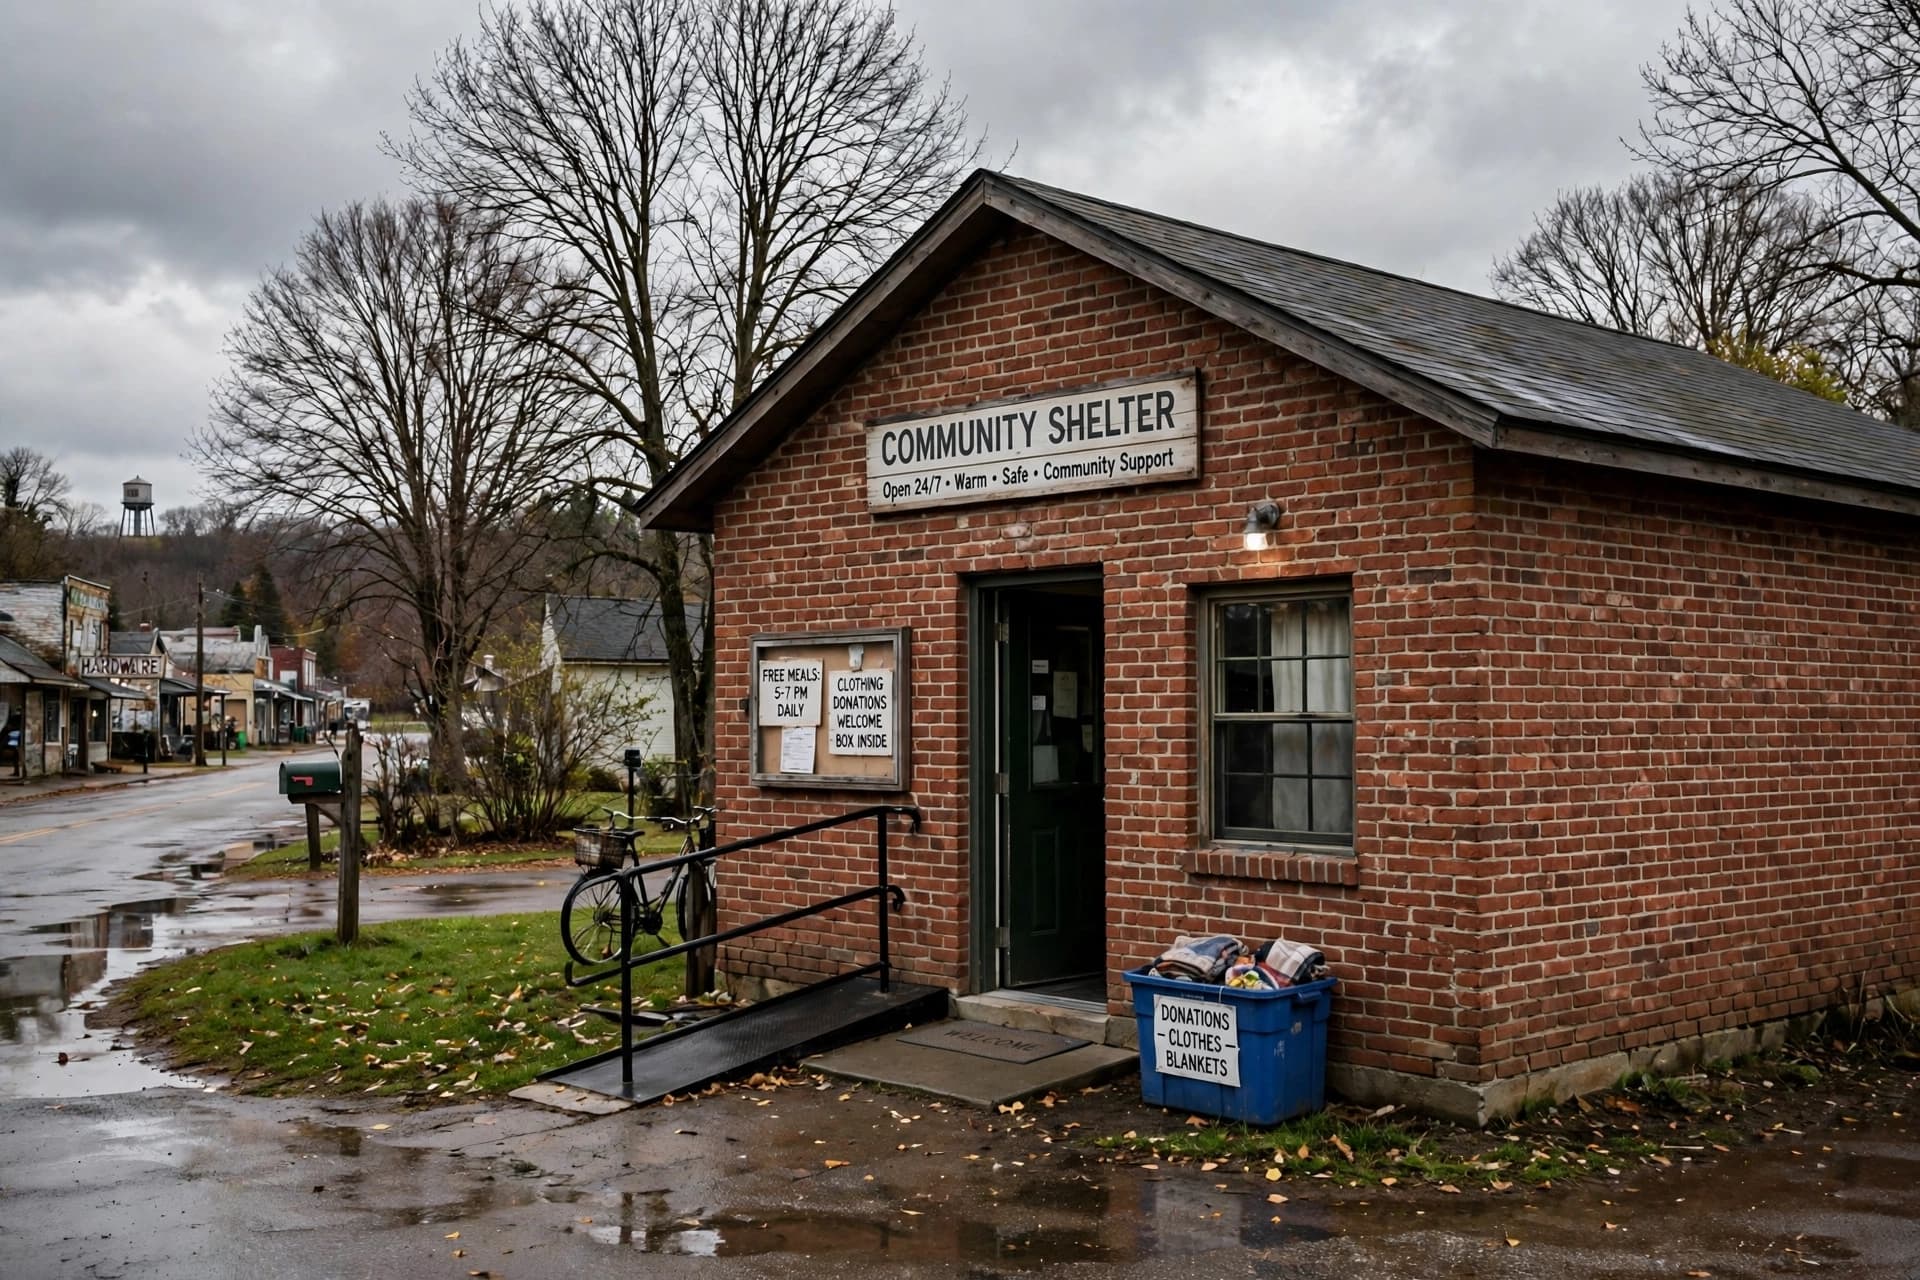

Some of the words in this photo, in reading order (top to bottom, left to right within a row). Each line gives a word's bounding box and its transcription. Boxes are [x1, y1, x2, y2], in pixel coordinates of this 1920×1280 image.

[881, 411, 1037, 466] COMMUNITY
[1048, 390, 1175, 444] SHELTER
[883, 482, 911, 502] Open
[914, 475, 941, 495] 24/7
[954, 473, 987, 491] Warm
[1002, 467, 1028, 486] Safe
[1043, 455, 1115, 480] Community
[1120, 448, 1174, 474] Support
[81, 658, 159, 675] HARDWARE
[762, 669, 785, 682] FREE
[788, 668, 820, 682] MEALS:
[774, 686, 790, 699] 5-7
[794, 686, 808, 699] PM
[837, 677, 883, 692] CLOTHING
[778, 704, 804, 717] DAILY
[833, 695, 887, 710] DONATIONS
[837, 714, 882, 728] WELCOME
[836, 734, 854, 748] BOX
[857, 734, 887, 748] INSIDE
[1161, 1004, 1230, 1031] DONATIONS
[944, 1029, 1041, 1051] WELCOME
[1168, 1028, 1222, 1053] CLOTHES
[1166, 1050, 1228, 1077] BLANKETS
